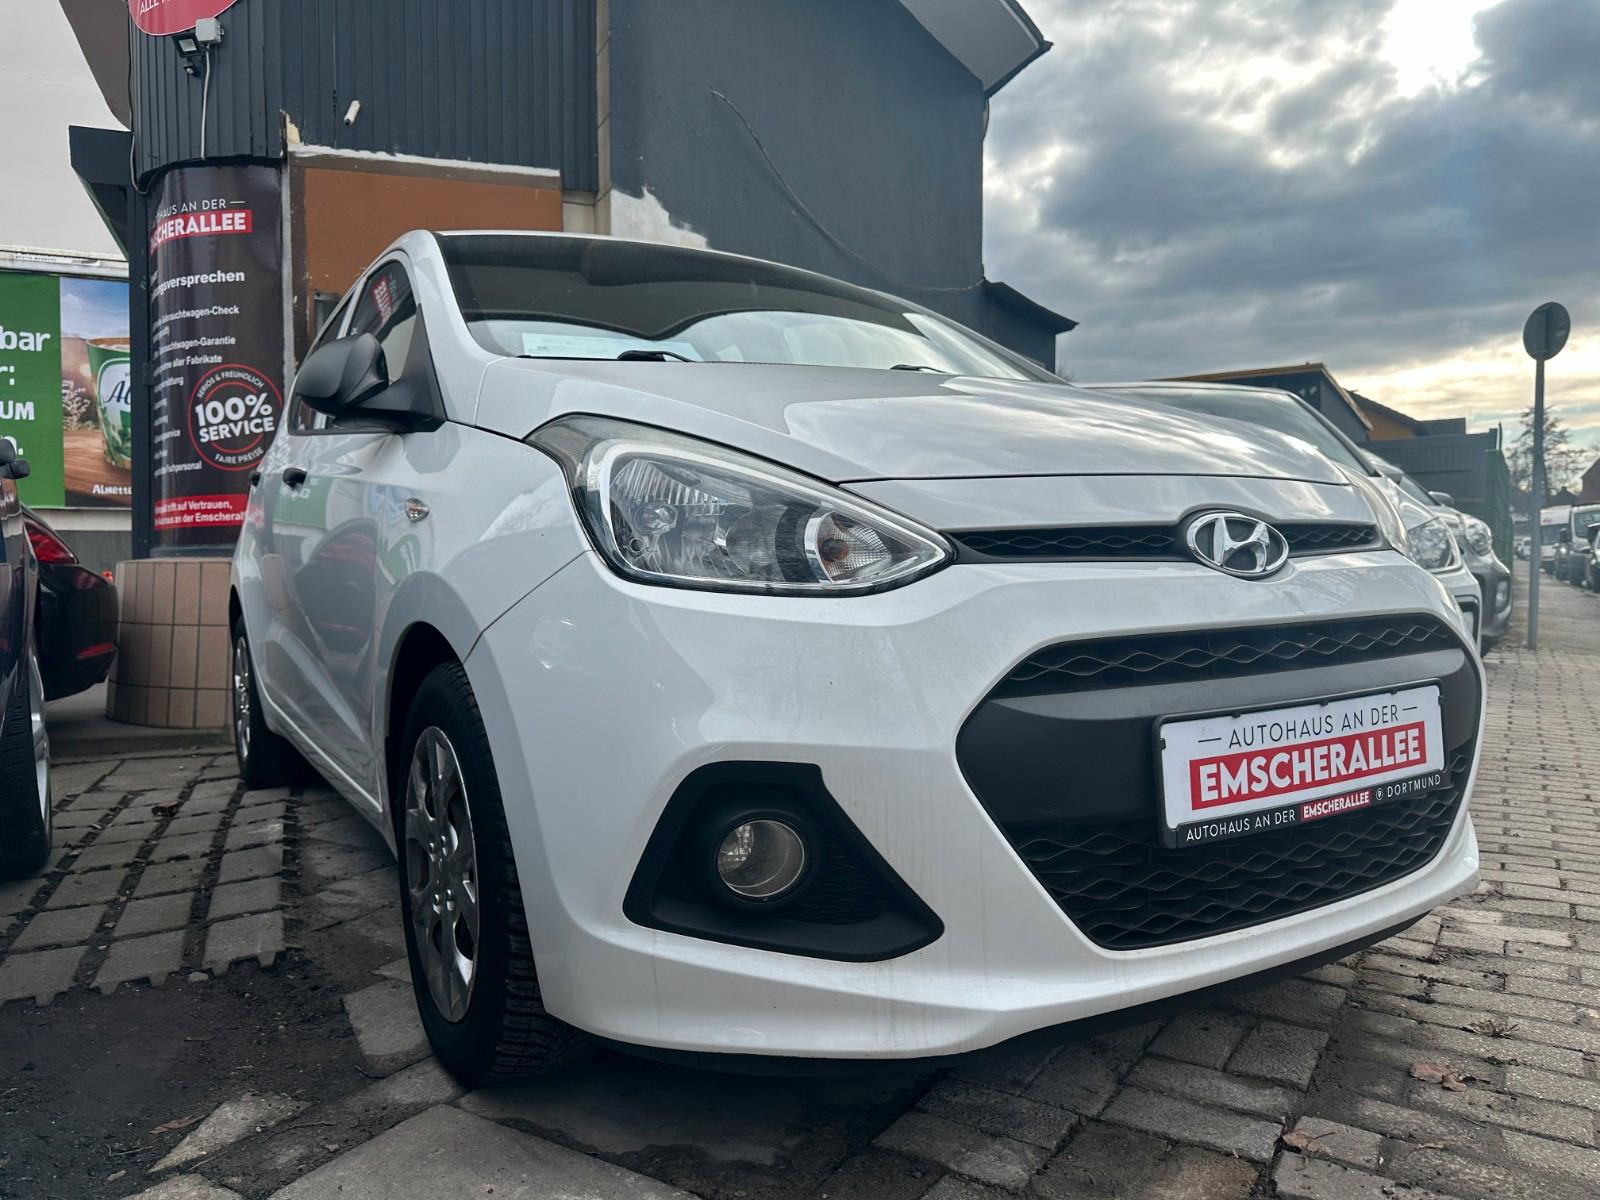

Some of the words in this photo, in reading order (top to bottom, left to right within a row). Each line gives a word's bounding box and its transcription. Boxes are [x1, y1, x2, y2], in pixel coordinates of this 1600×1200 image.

[181, 202, 197, 213] AN
[202, 199, 227, 210] DER
[186, 355, 223, 365] Fabrikate
[221, 370, 264, 388] FREUNDLICH
[195, 392, 273, 427] 100%
[199, 416, 276, 443] SERVICE
[215, 453, 237, 464] FAIRE
[238, 447, 265, 463] PREISE
[188, 500, 233, 510] Vertrauen,
[1228, 715, 1334, 749] AUTOHAUS
[1341, 710, 1364, 732] AN
[1371, 704, 1399, 726] DER
[1199, 728, 1421, 802] EMSCHERALLEE
[1186, 818, 1250, 842] AUTOHAUS
[1254, 814, 1271, 829] AN
[1275, 809, 1296, 825] DER
[1303, 791, 1370, 818] EMSCHERALLEE
[1387, 774, 1441, 798] DORTMUND
